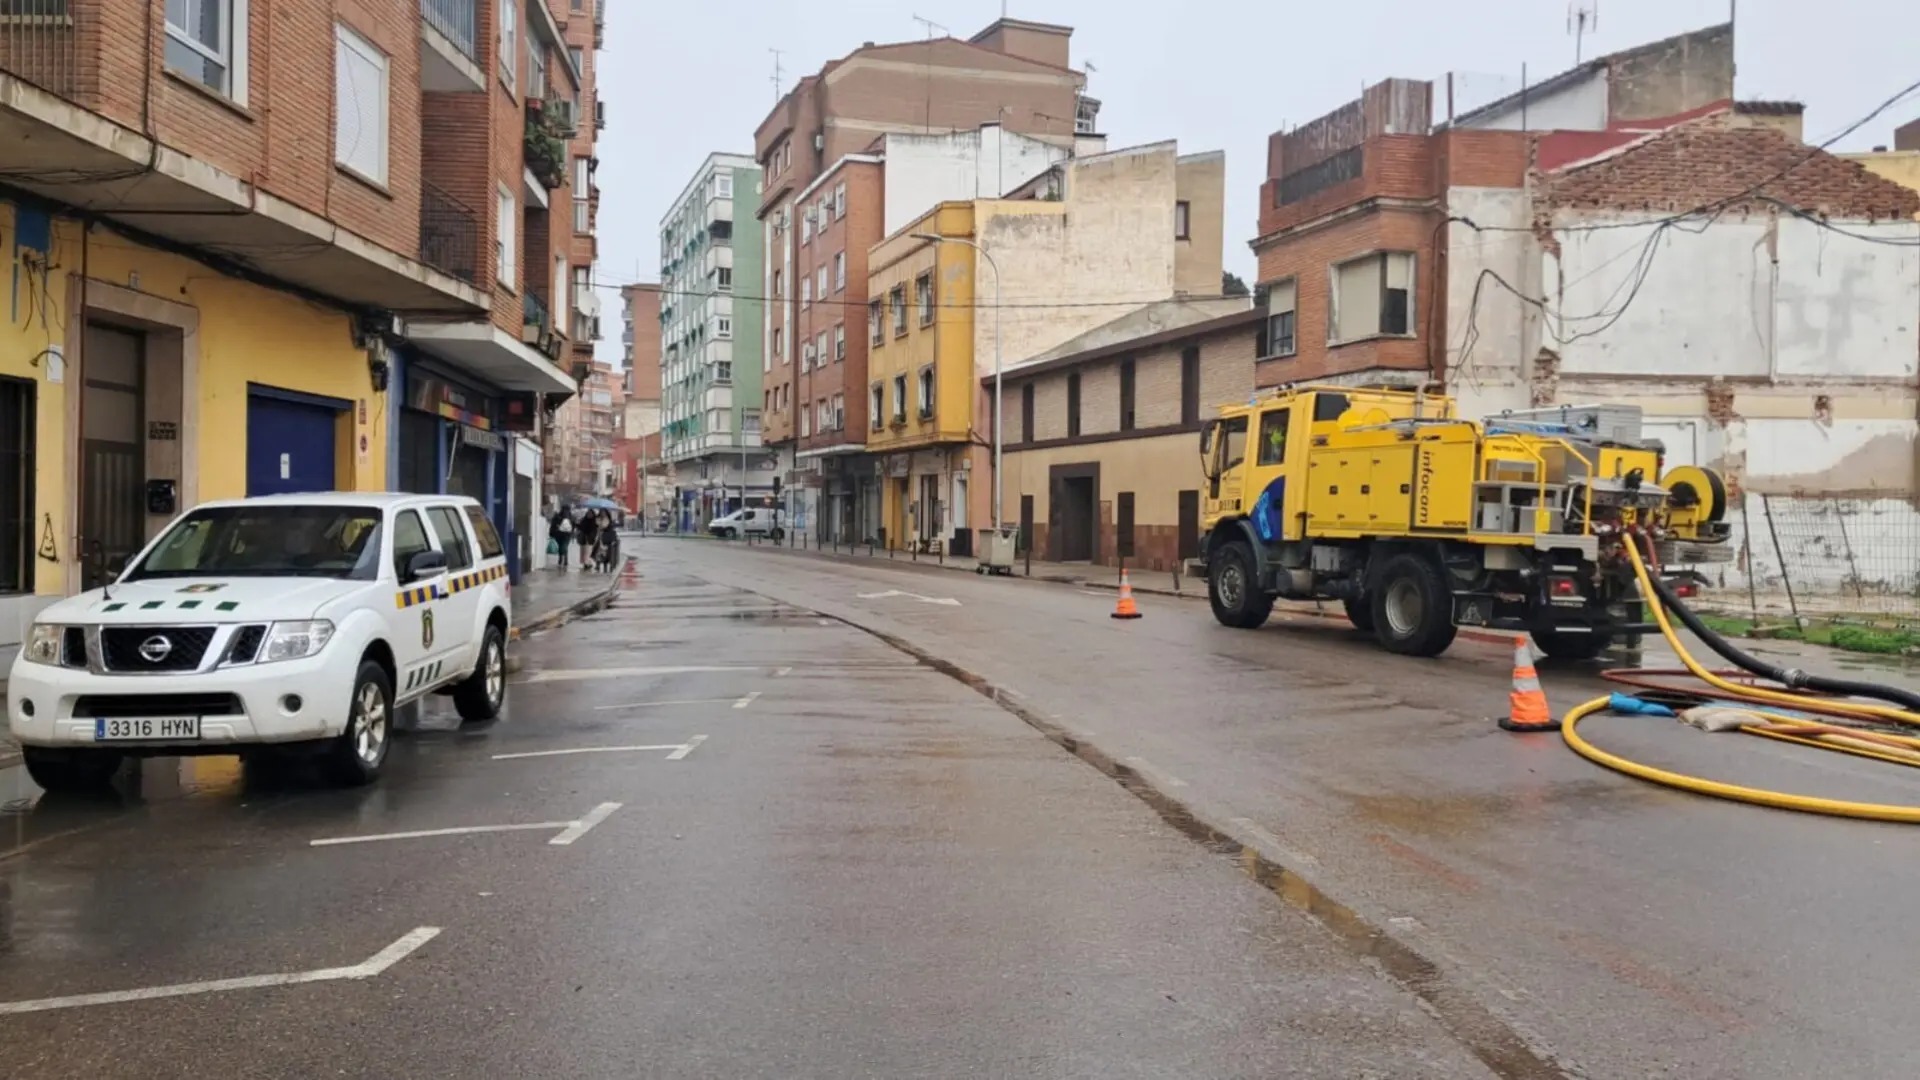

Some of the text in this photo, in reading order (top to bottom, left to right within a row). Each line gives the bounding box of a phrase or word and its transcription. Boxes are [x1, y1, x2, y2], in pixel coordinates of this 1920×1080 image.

[1420, 451, 1435, 524] infocam
[110, 719, 194, 737] 3316 HYN
